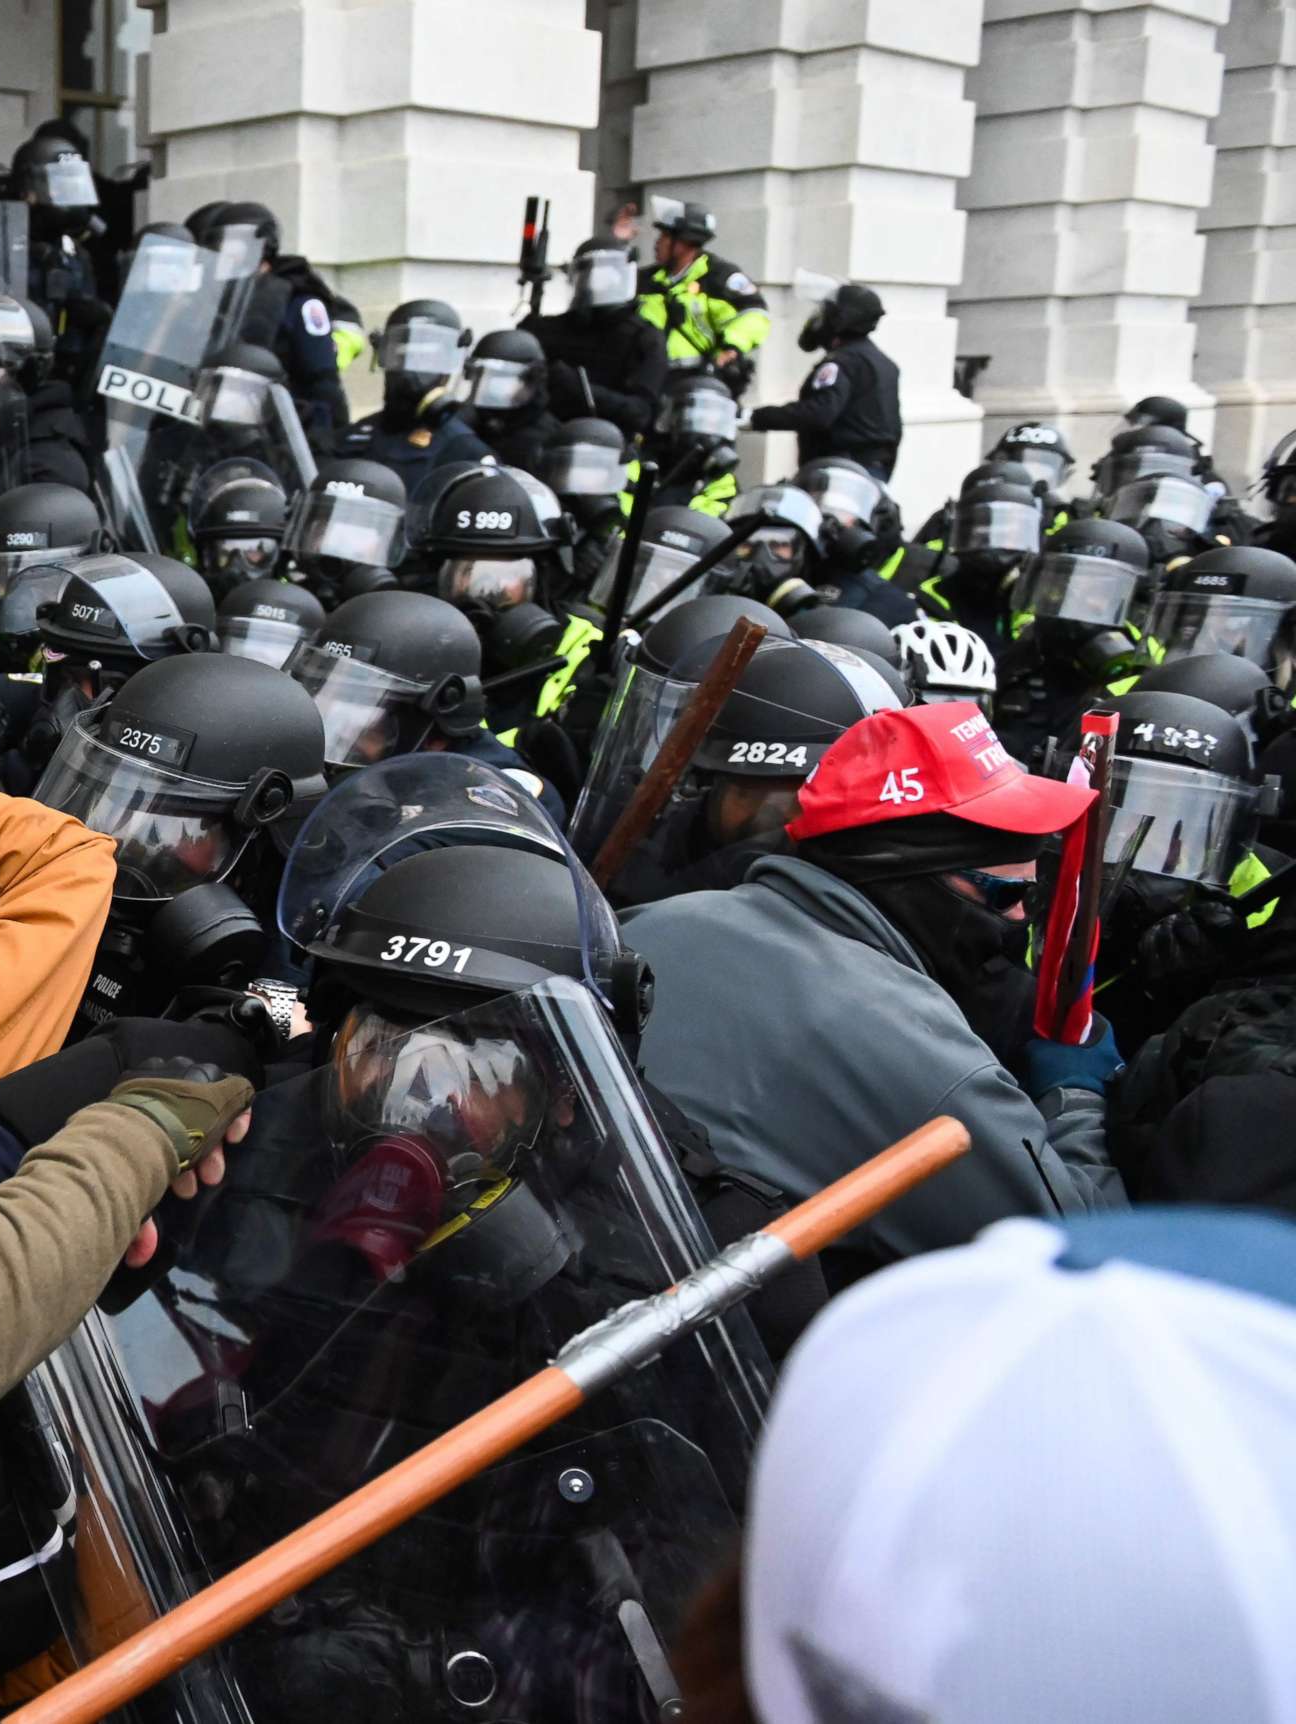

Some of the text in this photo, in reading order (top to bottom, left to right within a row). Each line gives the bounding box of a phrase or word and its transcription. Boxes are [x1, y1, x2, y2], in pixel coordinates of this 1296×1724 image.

[457, 510, 513, 530] S 999
[119, 727, 163, 754] 2375
[727, 741, 808, 768] 2824
[879, 767, 924, 805] 45
[380, 935, 473, 974] 3791
[92, 973, 123, 999] POLICE
